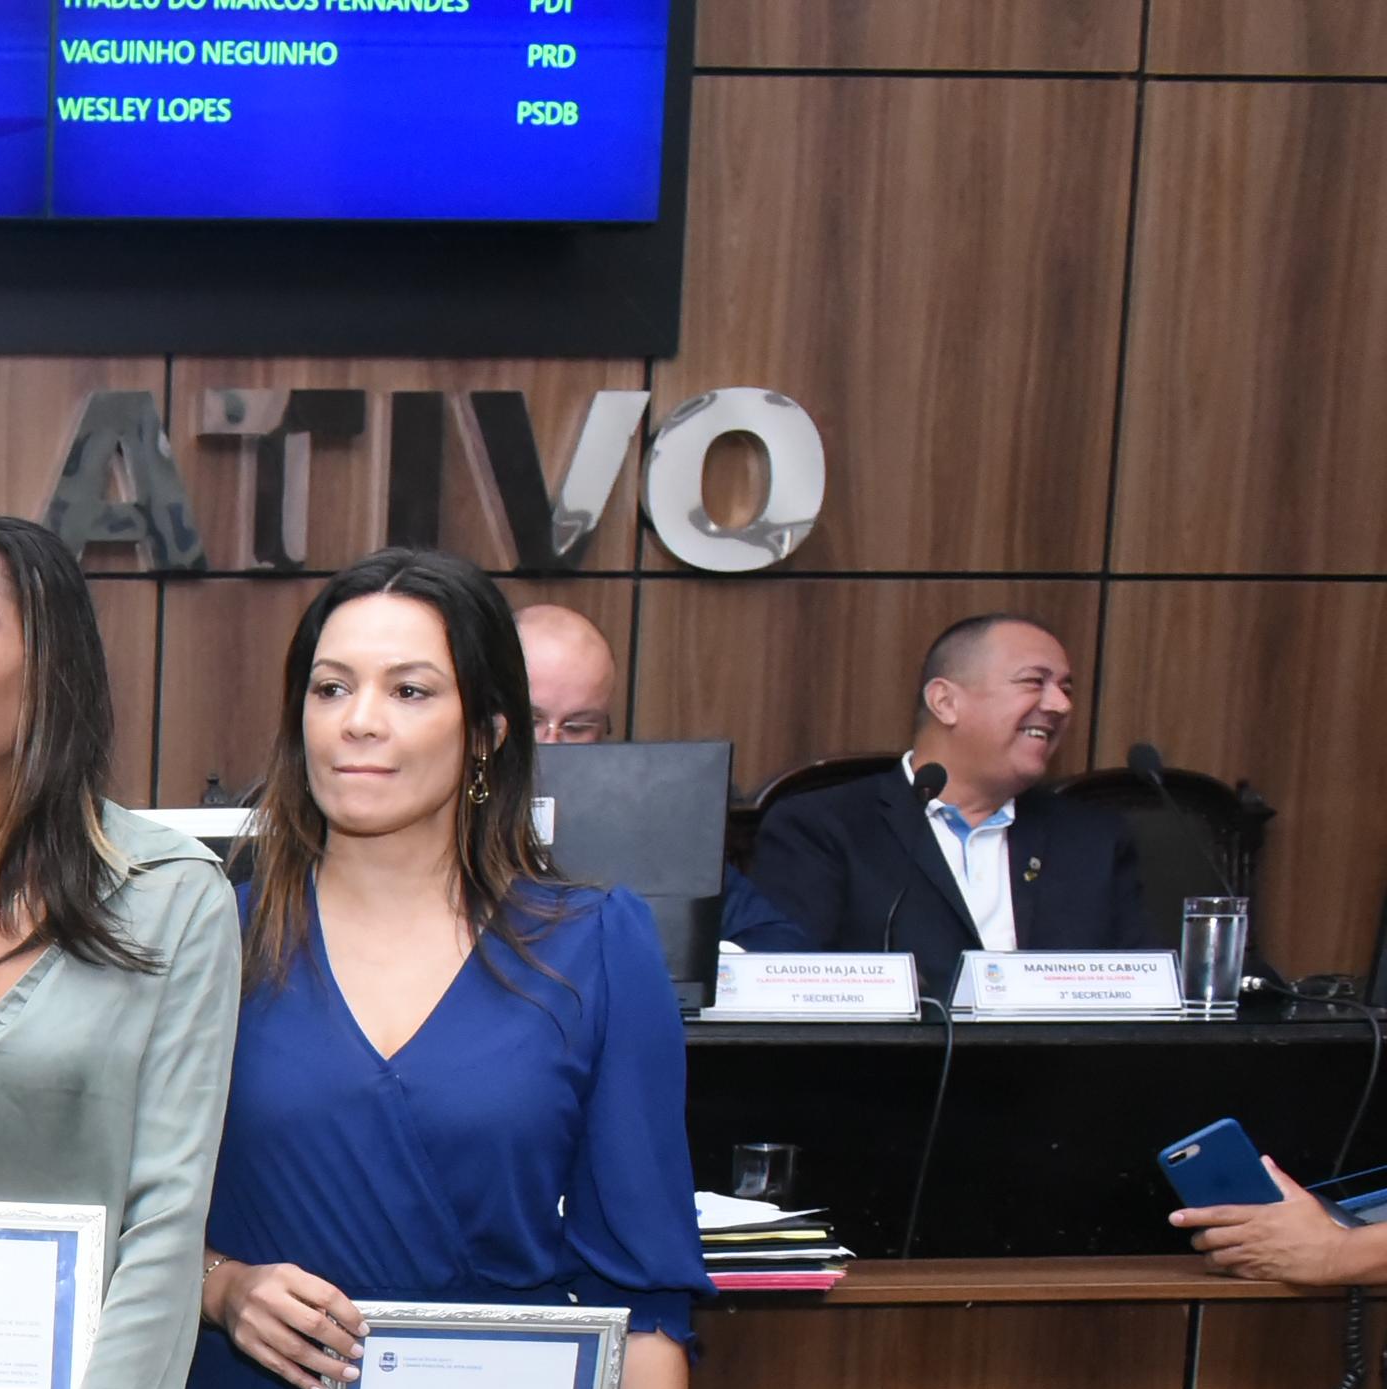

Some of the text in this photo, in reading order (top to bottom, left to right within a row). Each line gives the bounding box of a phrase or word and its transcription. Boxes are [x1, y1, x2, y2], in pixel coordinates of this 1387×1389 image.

[61, 39, 338, 66] VAGUINHO NEGUINHO
[528, 44, 576, 69] PRD
[57, 97, 231, 122] WESLEY LOPES
[517, 101, 579, 125] PSDB
[766, 965, 884, 976] CLAUDIO HAJA LUZ
[1024, 963, 1157, 974] MANINHO DE CABUÇU
